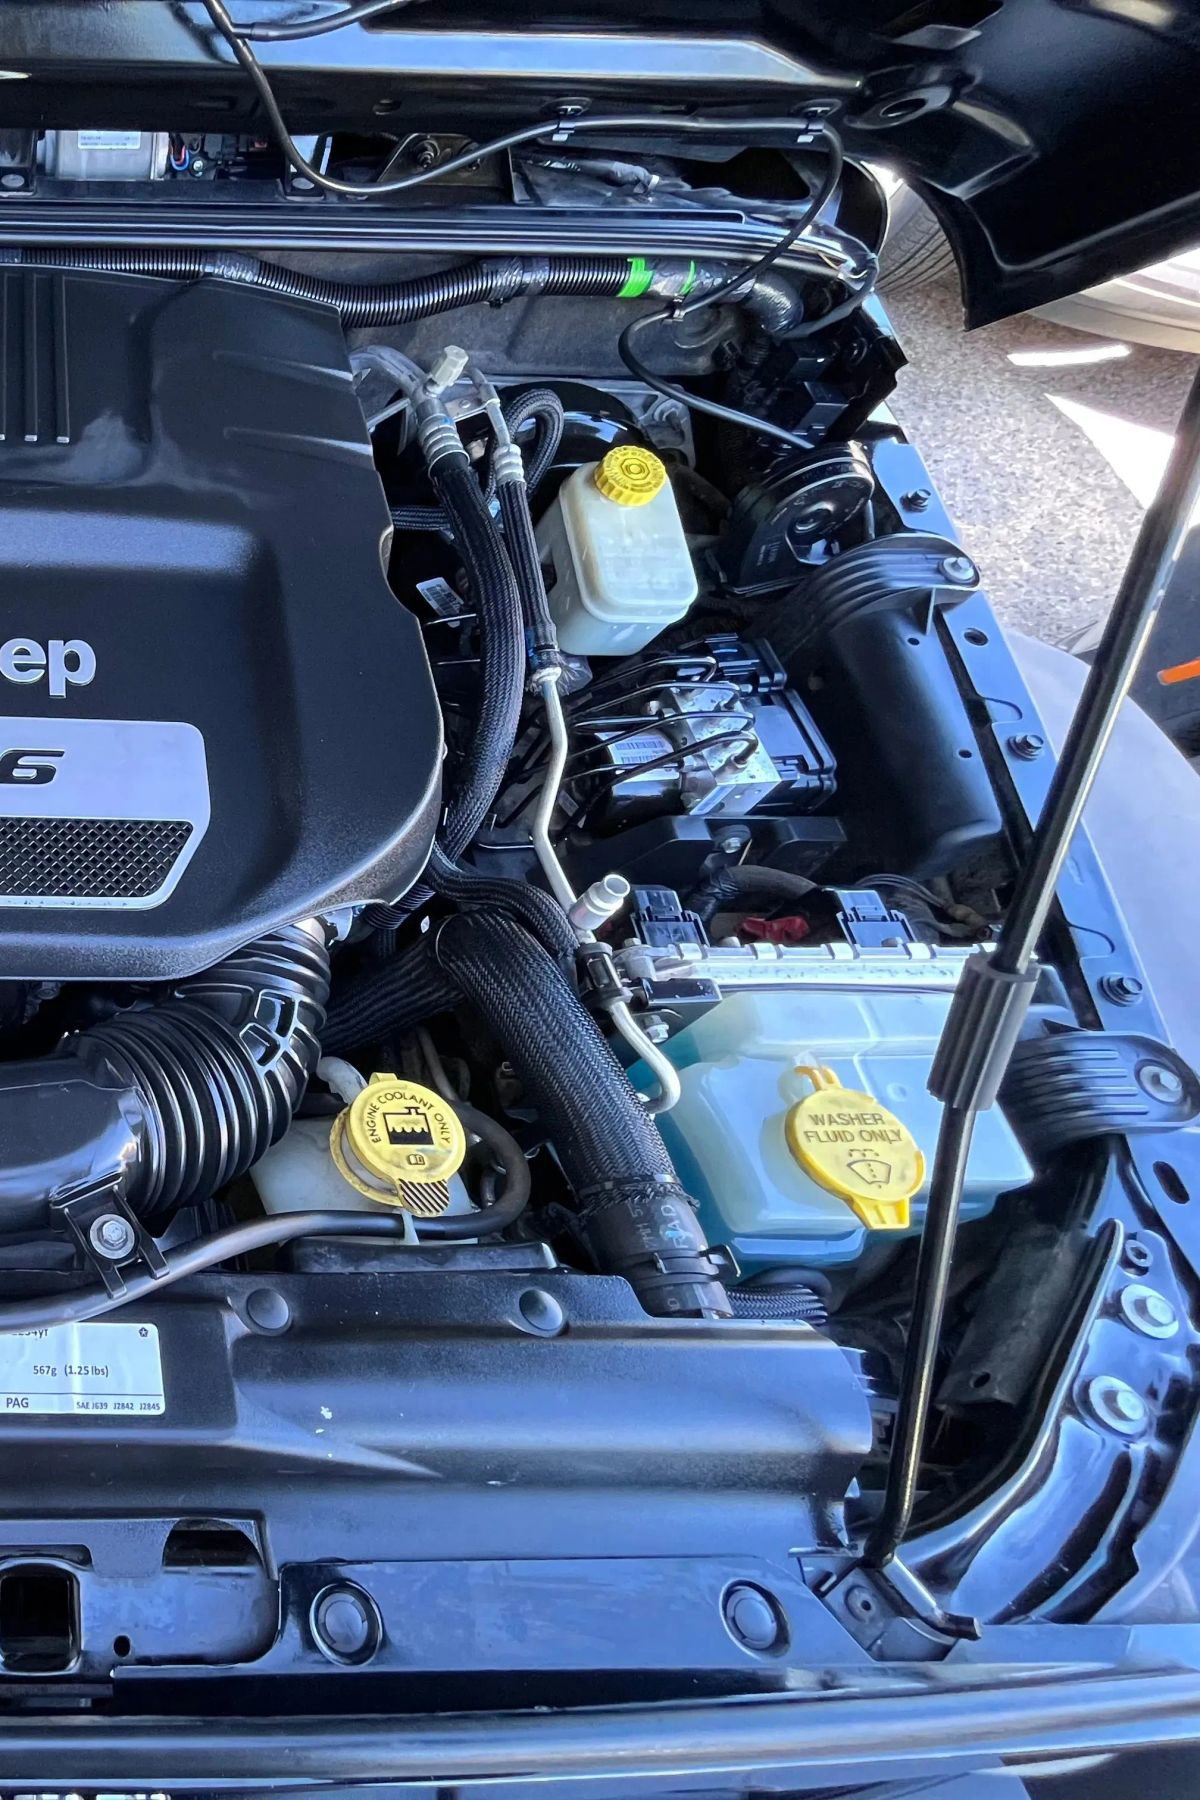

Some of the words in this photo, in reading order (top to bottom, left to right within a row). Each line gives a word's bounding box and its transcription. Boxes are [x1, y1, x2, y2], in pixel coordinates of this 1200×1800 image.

[366, 1102, 382, 1143] ENGINE
[377, 1091, 434, 1111] COOLANT
[434, 1112, 451, 1144] ONLY
[808, 1112, 886, 1126] WASHER
[803, 1130, 855, 1143] FLUID
[859, 1129, 903, 1145] ONLY
[33, 1364, 57, 1377] 567g
[64, 1364, 90, 1377] (1.25
[91, 1364, 109, 1378] lbs)
[6, 1397, 29, 1408] PAG
[76, 1402, 90, 1410] SAE
[91, 1402, 108, 1410] J639
[113, 1402, 134, 1410] J2842
[139, 1403, 161, 1411] J2845
